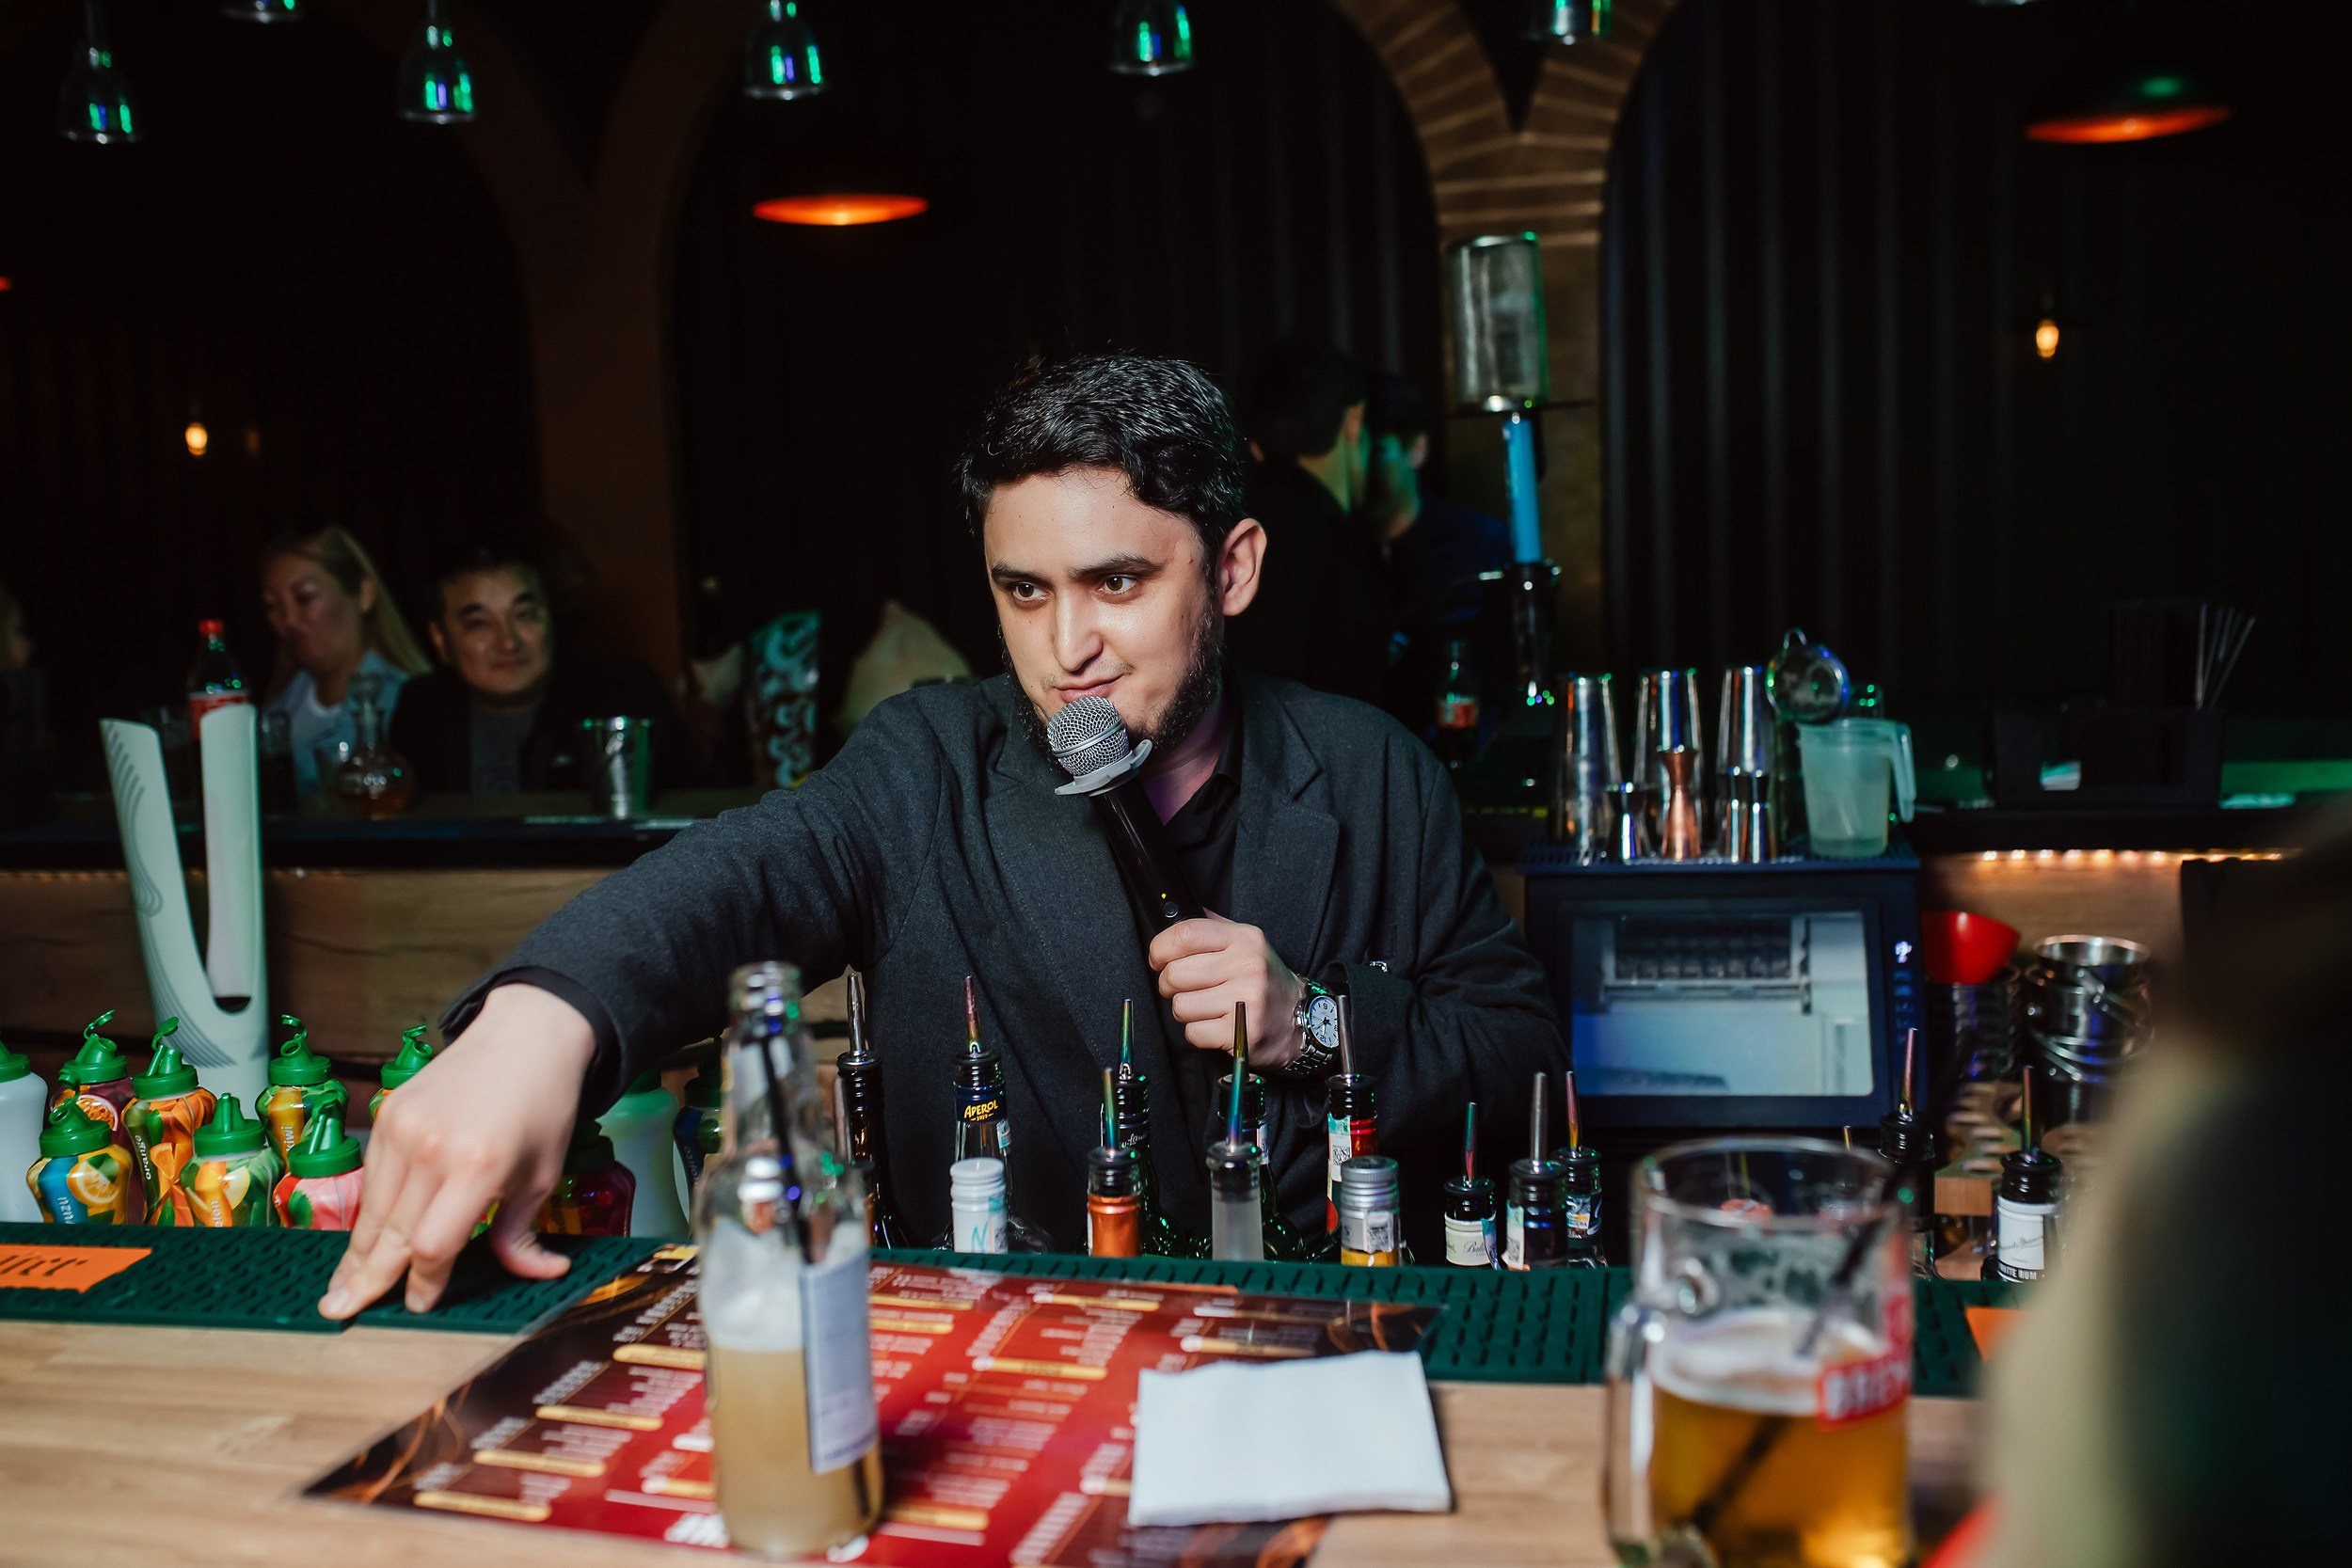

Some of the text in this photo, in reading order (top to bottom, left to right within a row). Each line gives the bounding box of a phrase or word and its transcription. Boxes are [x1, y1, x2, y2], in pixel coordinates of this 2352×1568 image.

[963, 1100, 999, 1118] APEROL
[281, 1126, 295, 1152] kiwi
[135, 1134, 151, 1180] orange
[211, 1199, 223, 1227] elon
[2018, 1269, 2037, 1280] RUM
